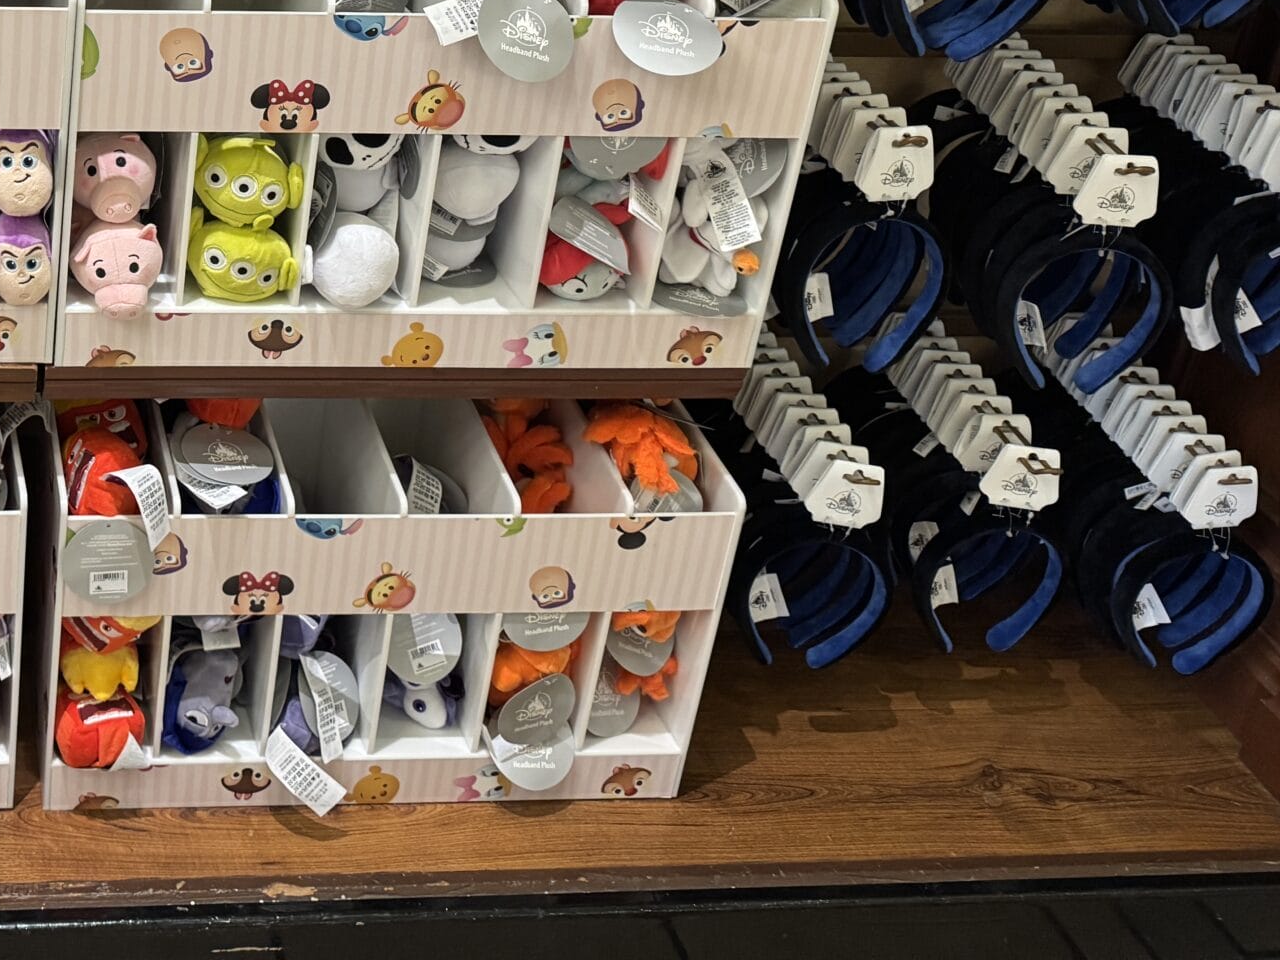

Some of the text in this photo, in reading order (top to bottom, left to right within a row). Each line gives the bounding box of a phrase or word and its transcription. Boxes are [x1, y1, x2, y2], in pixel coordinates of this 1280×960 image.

[500, 20, 550, 51] Disney
[638, 21, 693, 48] Disney
[501, 42, 550, 62] Headband Plush
[639, 42, 695, 58] Headband Plush
[513, 761, 556, 769] Headband Plush
